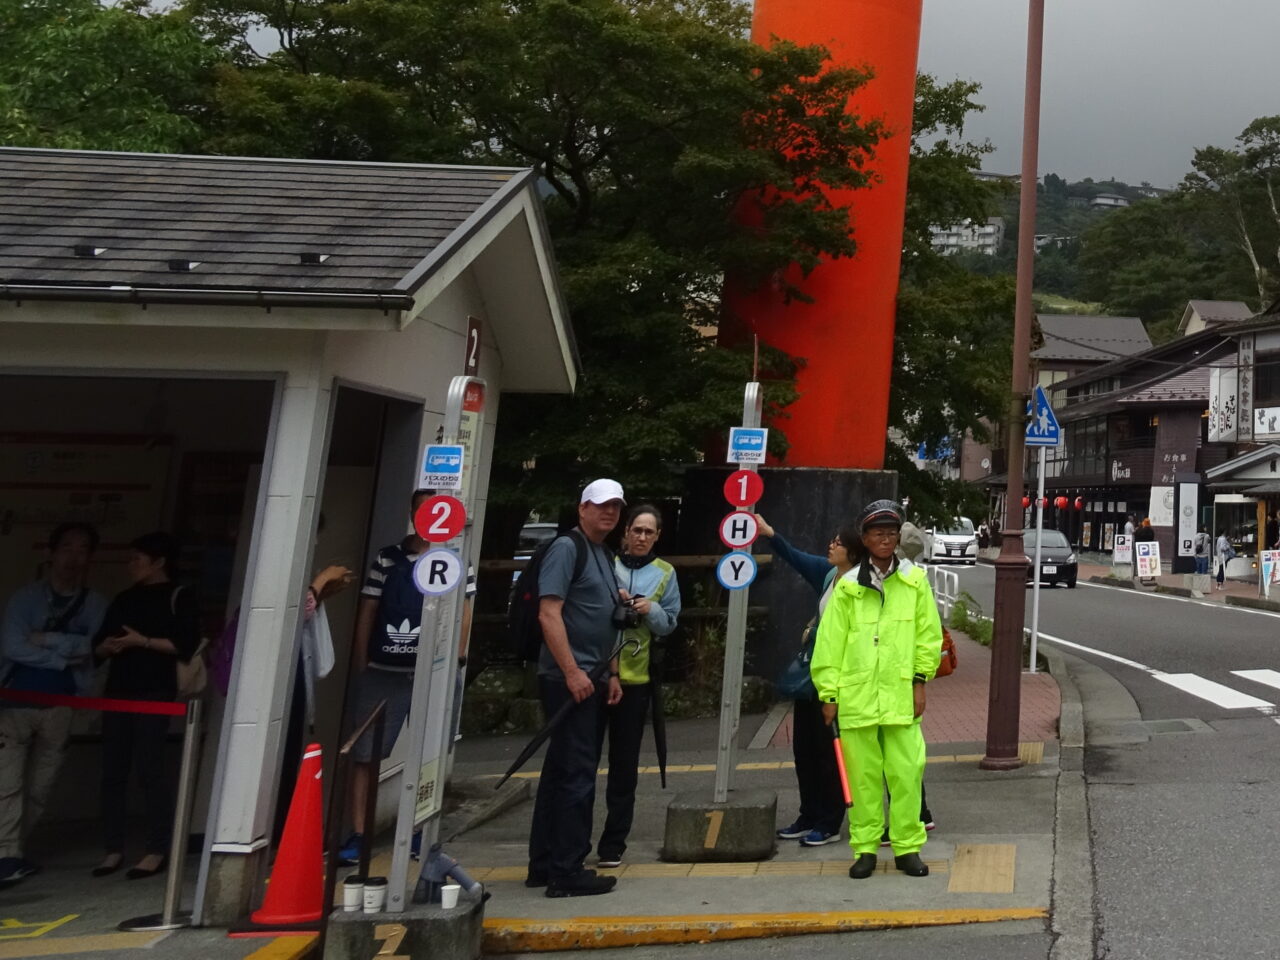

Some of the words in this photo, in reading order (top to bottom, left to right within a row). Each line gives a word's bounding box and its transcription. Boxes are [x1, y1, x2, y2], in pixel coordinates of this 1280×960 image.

[737, 474, 749, 501] 1
[428, 501, 452, 534] 2
[731, 519, 748, 540] H
[428, 559, 449, 585] R
[730, 560, 745, 581] Y
[704, 809, 724, 849] 1
